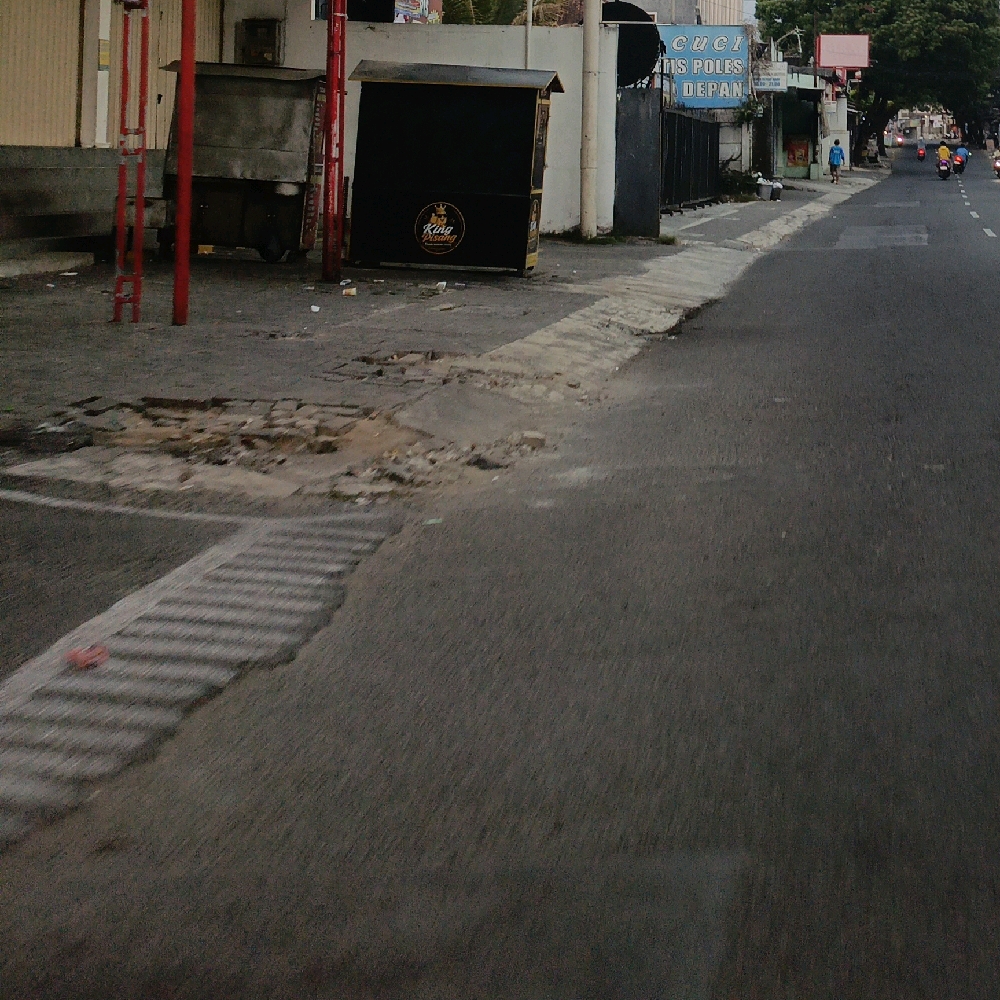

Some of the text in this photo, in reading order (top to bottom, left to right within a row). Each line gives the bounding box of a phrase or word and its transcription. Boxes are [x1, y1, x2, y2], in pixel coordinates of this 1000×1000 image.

[671, 34, 745, 53] CUCI
[692, 57, 745, 76] POLES
[681, 80, 745, 99] DEPAN
[421, 233, 458, 243] Pisang
[423, 223, 454, 236] King
